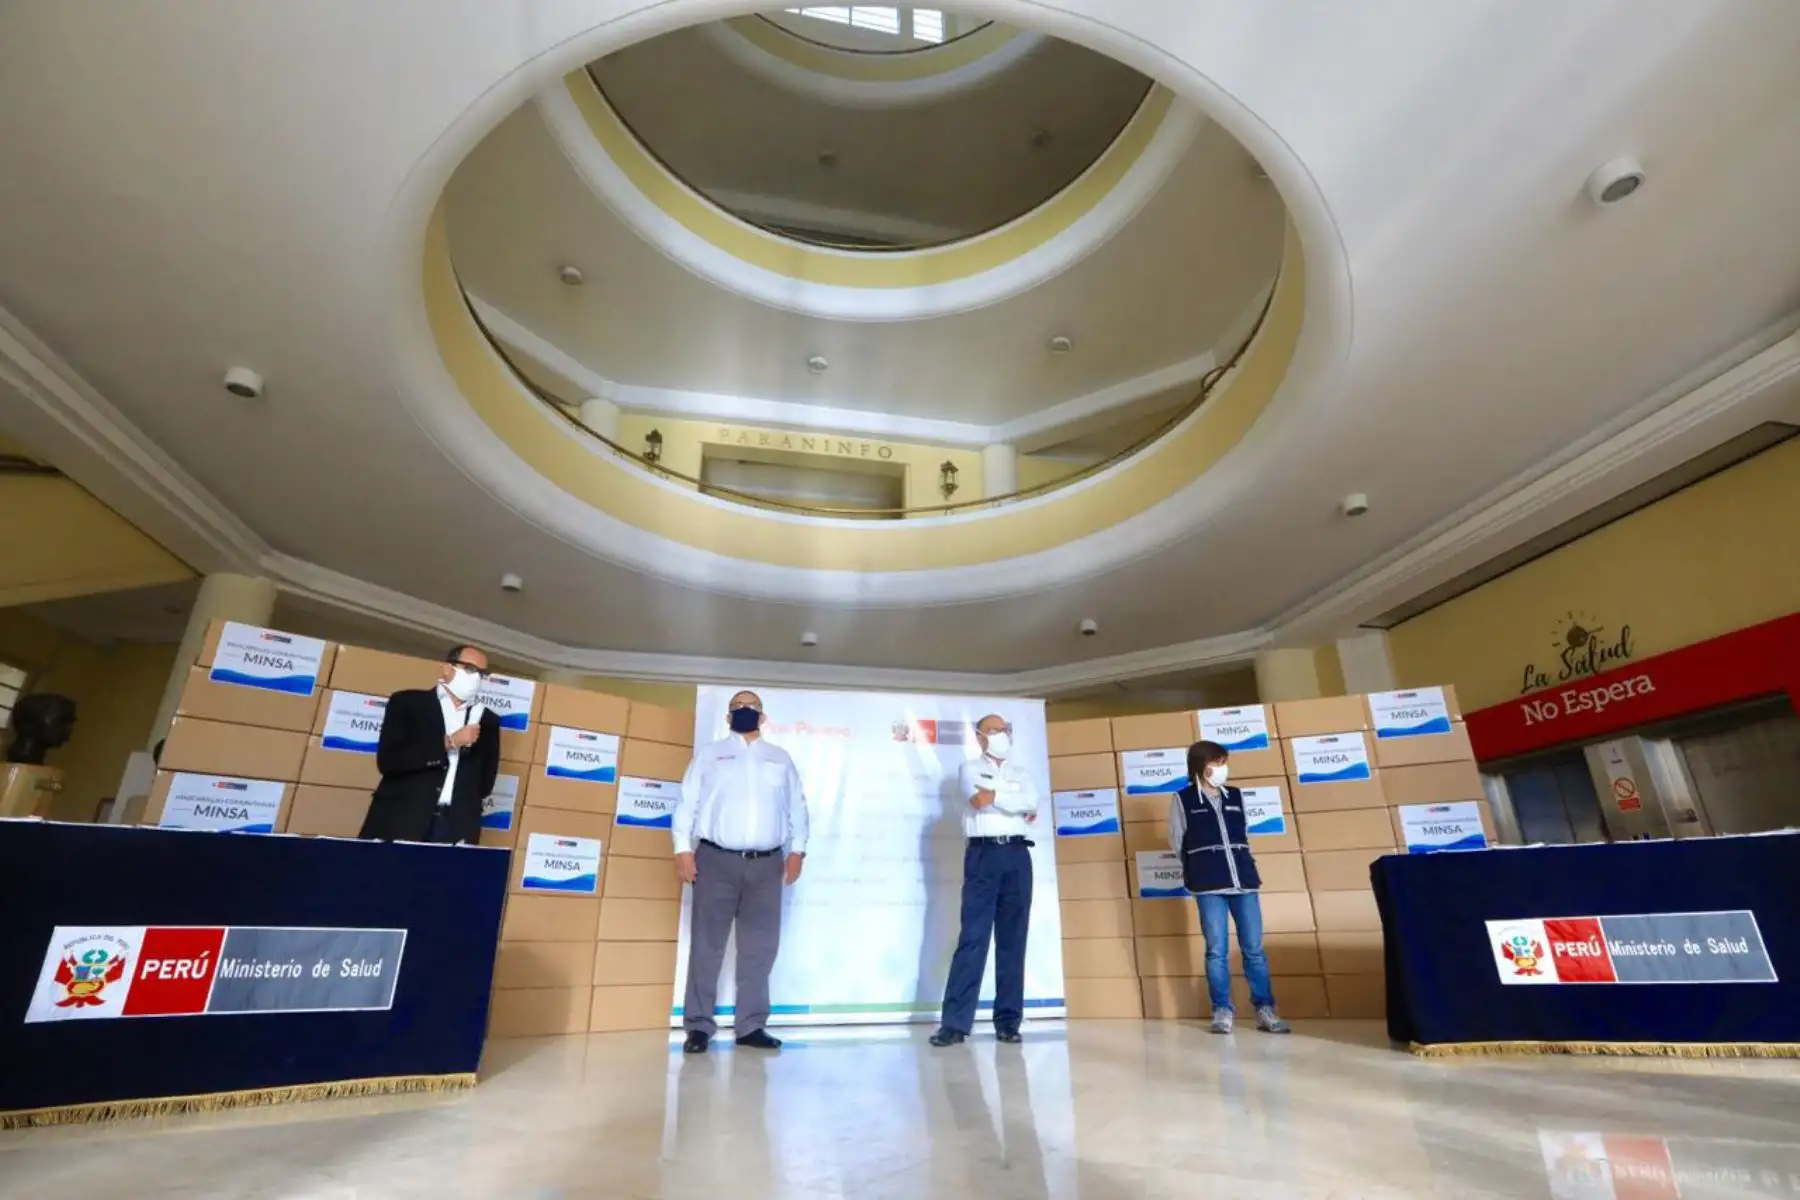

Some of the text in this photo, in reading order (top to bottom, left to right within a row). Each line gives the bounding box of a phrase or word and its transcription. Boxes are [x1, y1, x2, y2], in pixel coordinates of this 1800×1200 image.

[717, 428, 893, 460] PARANINFO
[243, 652, 293, 670] MINSA
[1521, 624, 1634, 694] La Salud
[474, 694, 513, 710] MINSA
[1521, 674, 1656, 726] No Espera
[1390, 708, 1428, 721] MINSA
[350, 718, 381, 733] MIN
[1216, 725, 1251, 736] MINSA
[565, 750, 601, 764] MINSA
[1312, 753, 1349, 765] MINSA
[1139, 767, 1173, 778] MINSA
[193, 803, 249, 820] MINSA
[633, 799, 667, 811] MINSA
[1069, 807, 1103, 819] MINSA
[1421, 824, 1464, 836] MINSA
[543, 858, 581, 872] MINSA
[1154, 871, 1183, 881] MINS
[1553, 935, 1749, 958] PERÚ Ministerio de Salud
[140, 950, 384, 980] PERÚ Ministerio de Salud
